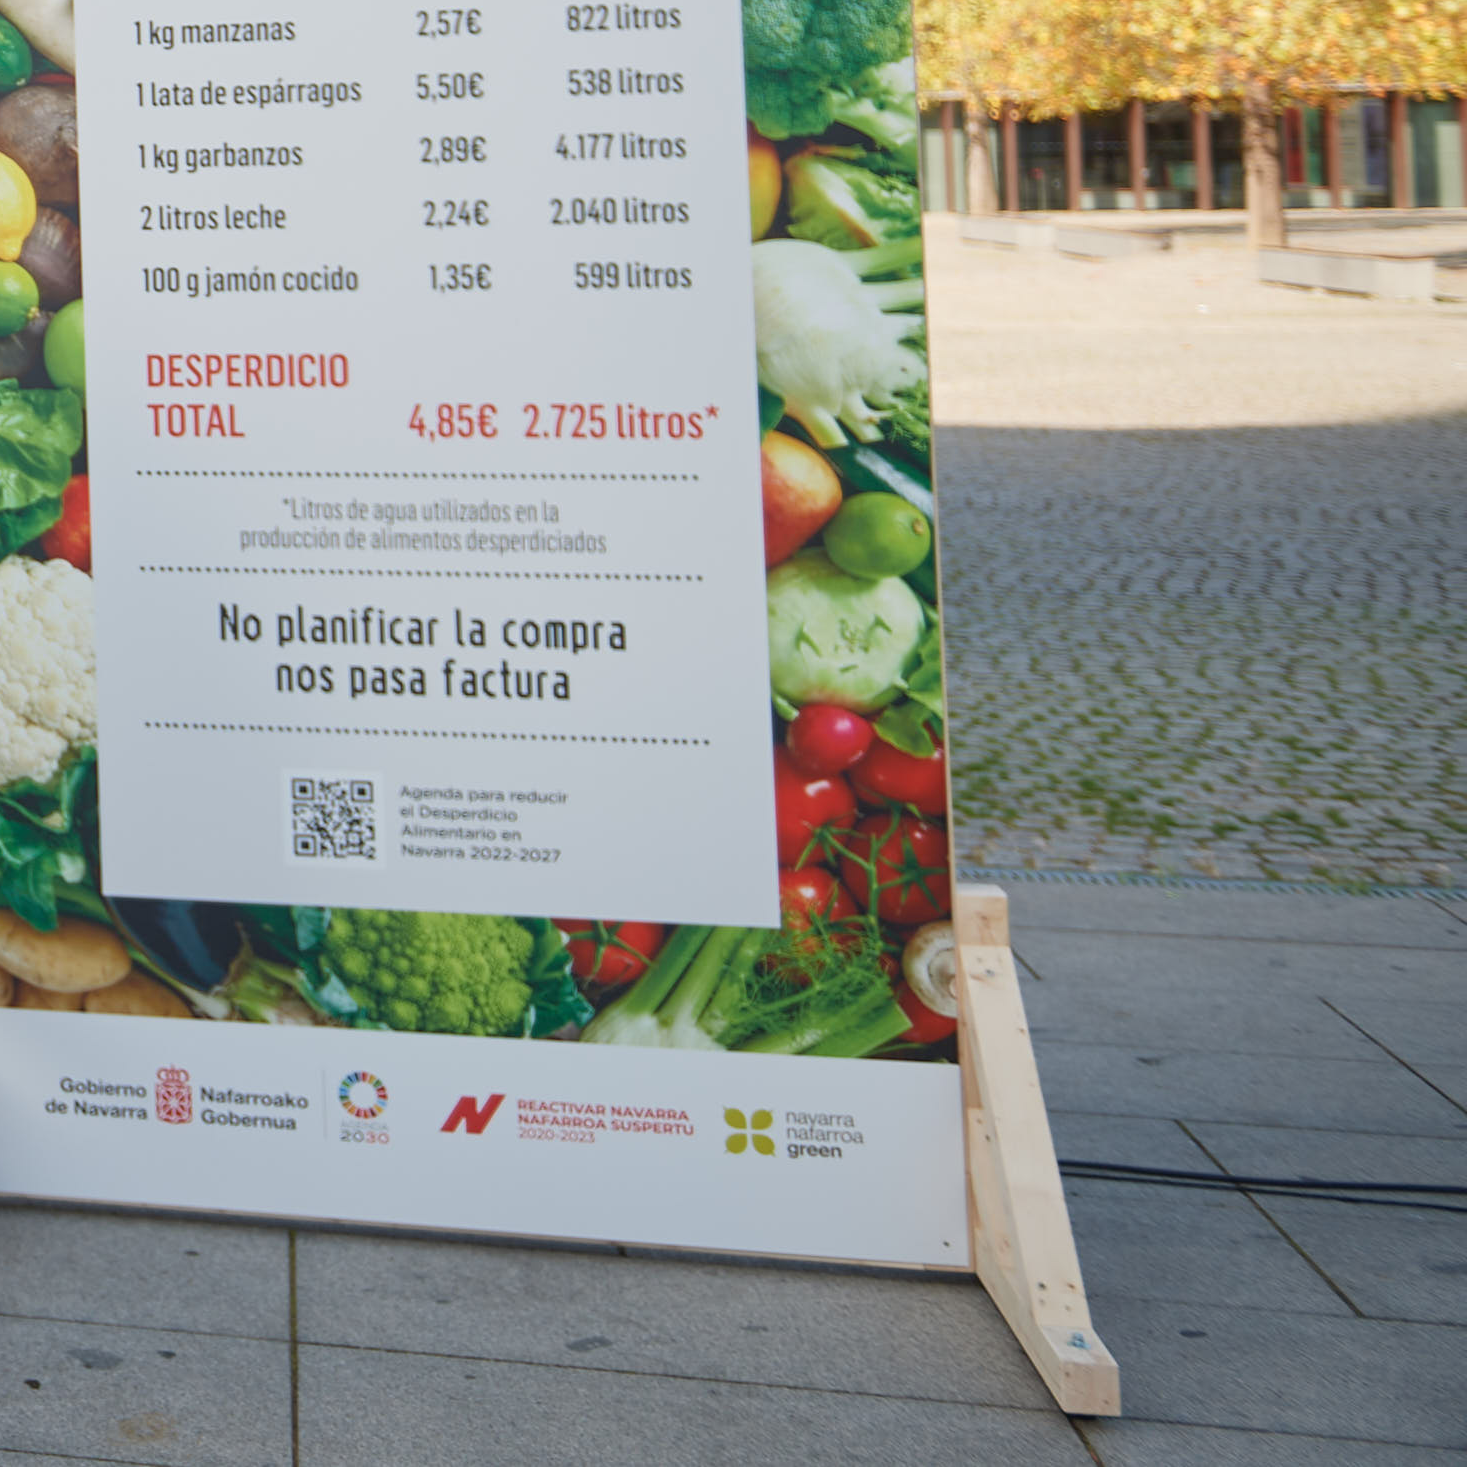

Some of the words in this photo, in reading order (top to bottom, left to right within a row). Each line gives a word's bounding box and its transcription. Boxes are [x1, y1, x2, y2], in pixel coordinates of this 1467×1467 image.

[134, 21, 142, 45] 1
[149, 20, 174, 50] kg
[181, 21, 296, 44] manzanas
[416, 8, 482, 38] 2,57€
[566, 4, 609, 32] 822
[616, 2, 682, 30] litros
[136, 82, 144, 106] 1
[151, 81, 194, 106] lata
[200, 80, 227, 105] de
[233, 78, 362, 109] espárragos
[416, 72, 485, 103] 5,50€
[568, 68, 612, 96] 538
[618, 67, 684, 95] litros
[138, 144, 146, 168] 1
[153, 143, 179, 173] kg
[185, 142, 304, 173] garbanzos
[420, 136, 487, 165] 2,89€
[555, 133, 614, 160] 4.177
[621, 132, 687, 159] litros
[140, 205, 153, 231] 2
[159, 204, 218, 231] litros
[224, 203, 286, 230] leche
[423, 200, 489, 230] 2,24€
[550, 198, 617, 225] 2.040
[624, 197, 690, 224] litros
[205, 265, 276, 298] jamón
[283, 265, 359, 292] cocido
[429, 263, 492, 294] 1,35€
[575, 262, 620, 289] 599
[626, 261, 693, 289] litros
[147, 353, 349, 388] DESPERDICIO
[147, 403, 246, 438] TOTAL
[409, 403, 498, 444] 4,85€
[523, 403, 607, 439] 2.725
[347, 498, 368, 520] de
[373, 501, 417, 526] agua
[422, 498, 511, 523] utilizados
[515, 504, 537, 523] en
[542, 501, 559, 523] la
[240, 527, 339, 551] producción
[344, 527, 365, 550] de
[370, 528, 462, 551] alimentos
[468, 530, 607, 556] desperdiciados
[220, 603, 262, 642] No
[277, 605, 439, 648] planificar
[455, 609, 486, 648] la
[503, 618, 627, 654] compra
[276, 662, 334, 694] nos
[350, 664, 426, 699] pasa
[444, 659, 571, 700] factura
[400, 785, 463, 801] Agenda
[468, 788, 505, 803] para
[510, 790, 568, 805] reducir
[400, 806, 414, 818] el
[419, 805, 518, 822] Desperdicio
[402, 824, 497, 842] Alimentario
[501, 829, 522, 842] en
[402, 844, 465, 859] Navarra
[470, 845, 562, 863] 2022-2027
[59, 1077, 147, 1098] Gobierno
[200, 1086, 309, 1110] Nafarroako
[45, 1098, 69, 1115] de
[73, 1100, 148, 1121] Navarra
[201, 1109, 297, 1131] Gobernua
[517, 1099, 606, 1116] REACTIVAR
[611, 1106, 689, 1122] NAVARRA
[518, 1114, 607, 1131] NAFARROA
[611, 1119, 695, 1137] SUSPERTU
[519, 1127, 596, 1144] 2020-2023
[340, 1130, 390, 1145] 2030
[787, 1143, 842, 1159] green
